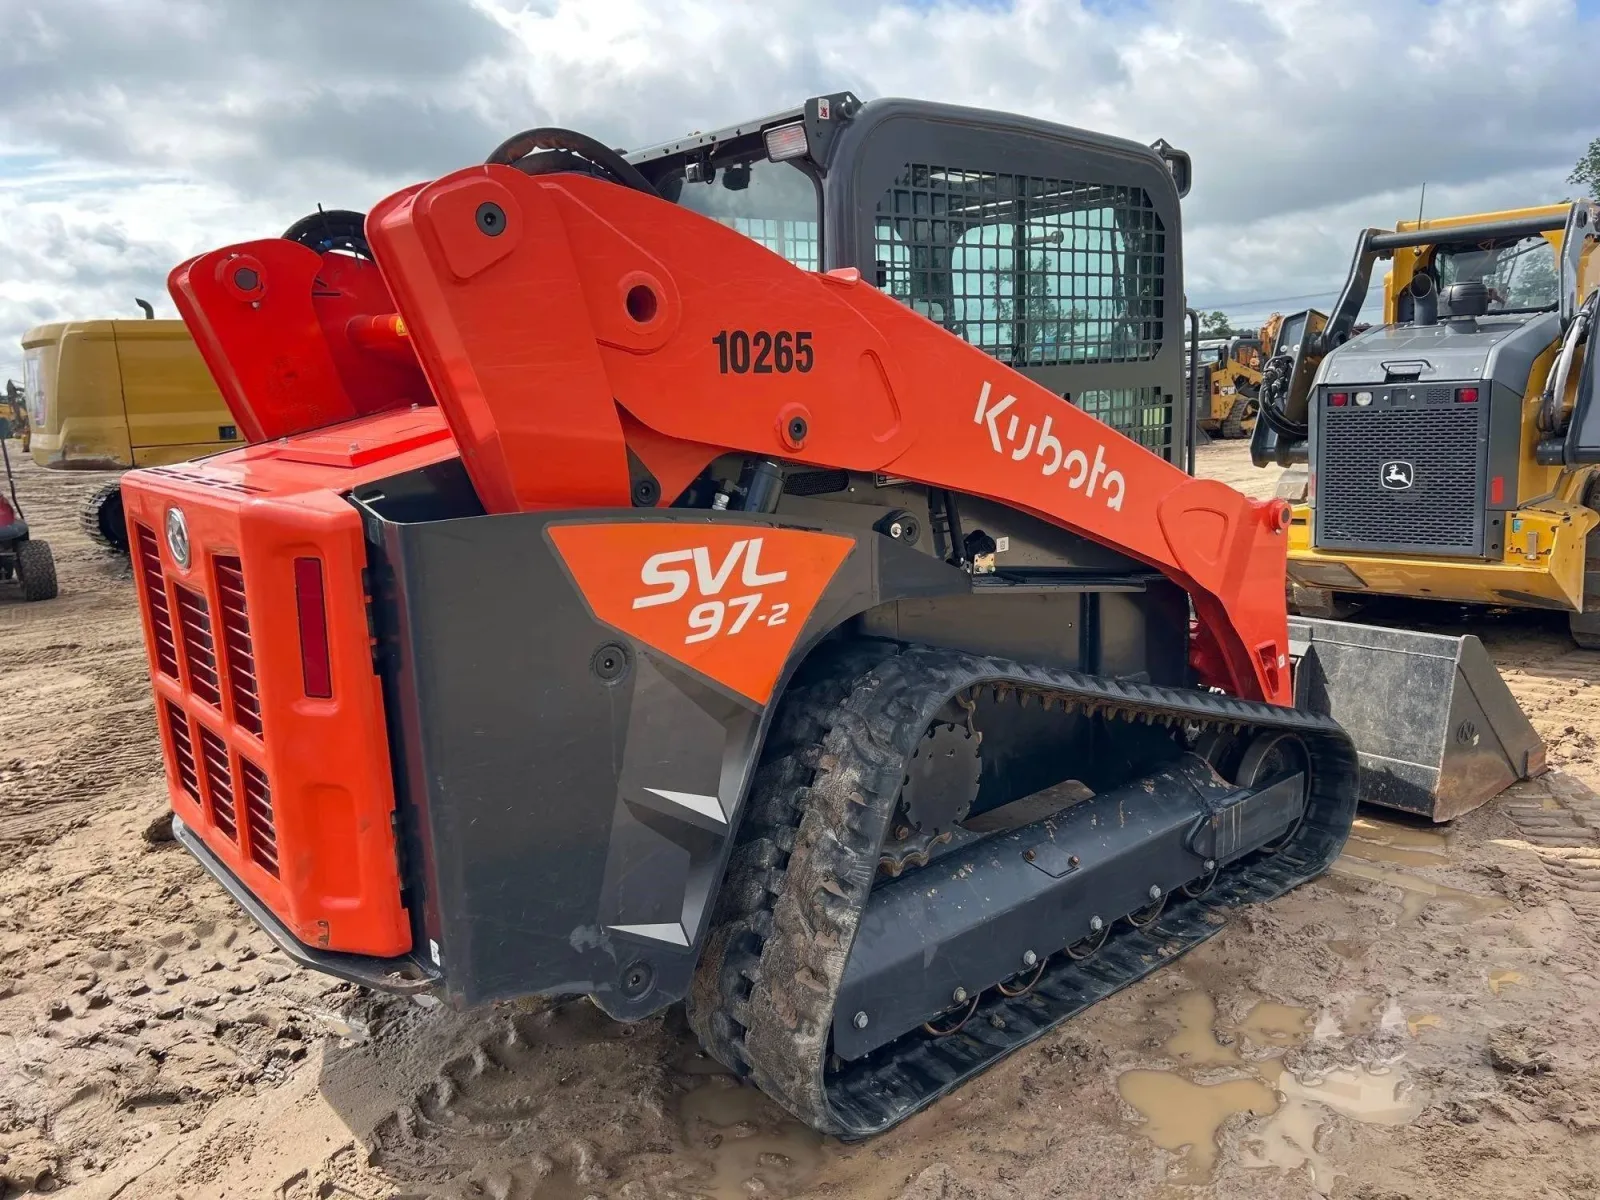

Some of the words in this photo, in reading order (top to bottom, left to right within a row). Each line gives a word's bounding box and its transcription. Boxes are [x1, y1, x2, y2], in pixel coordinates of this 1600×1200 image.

[712, 330, 814, 374] 10265
[973, 381, 1125, 512] Kubota
[632, 537, 788, 610] SVL
[684, 593, 790, 644] 97-2
